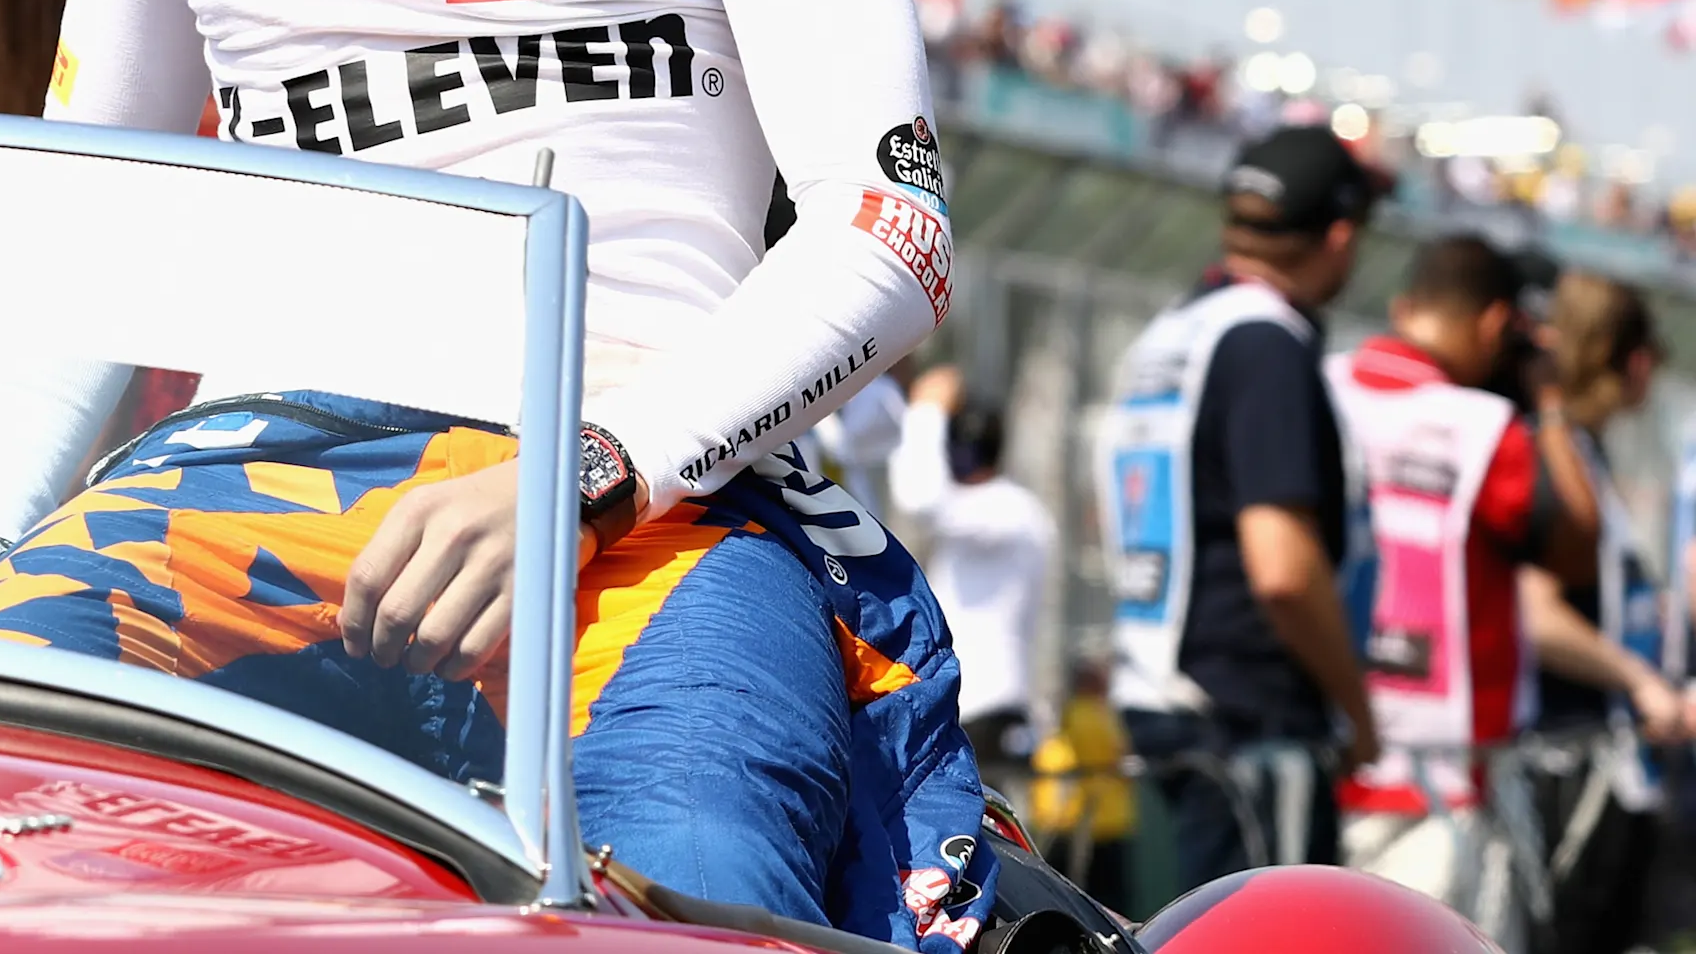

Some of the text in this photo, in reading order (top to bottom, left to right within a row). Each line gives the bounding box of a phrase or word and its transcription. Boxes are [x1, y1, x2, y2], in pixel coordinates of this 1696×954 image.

[894, 158, 944, 198] Galici
[678, 400, 792, 490] RICHARD
[800, 337, 879, 410] MILLE
